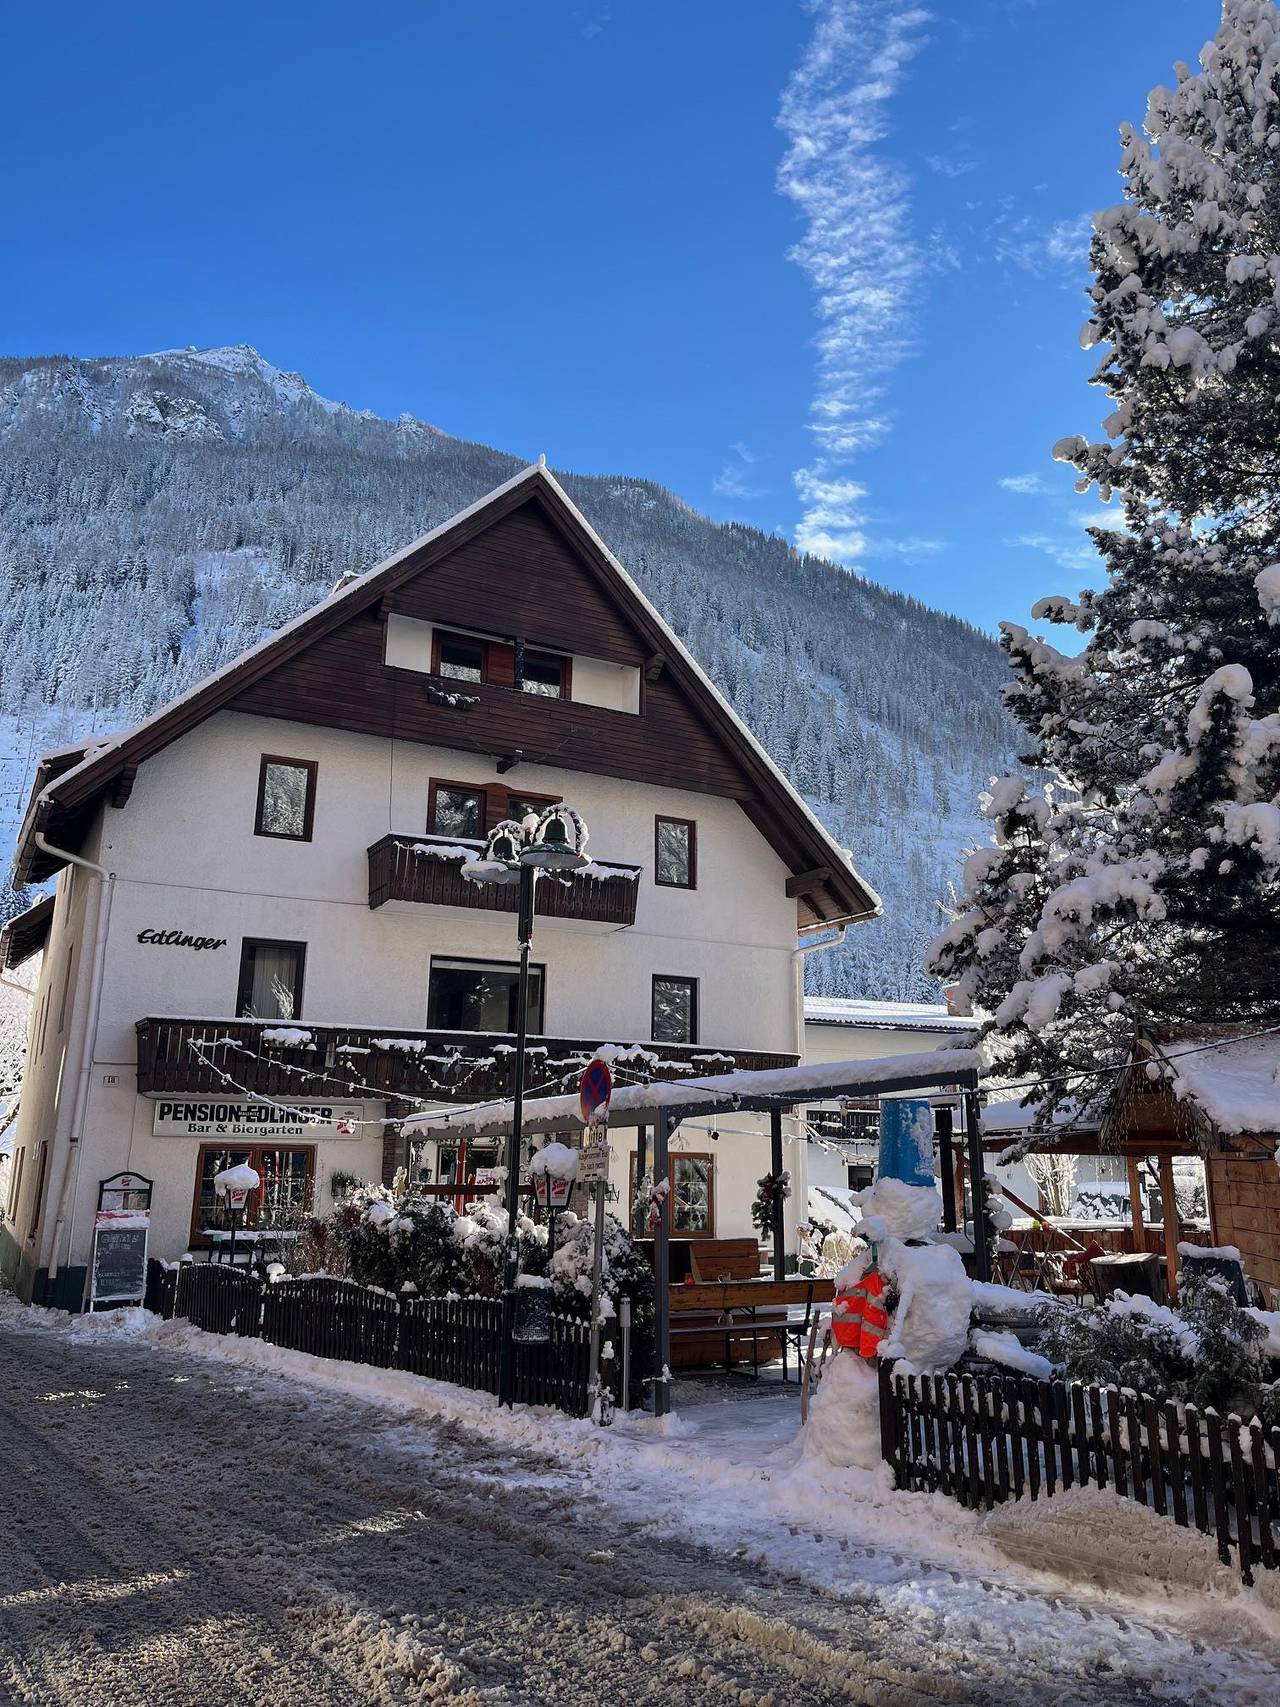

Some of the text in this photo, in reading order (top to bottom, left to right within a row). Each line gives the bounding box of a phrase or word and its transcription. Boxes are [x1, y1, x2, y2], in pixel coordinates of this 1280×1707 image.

[136, 928, 227, 951] Edlinger
[158, 1102, 242, 1123] PENSION
[187, 1123, 304, 1137] Bar & Biergarten
